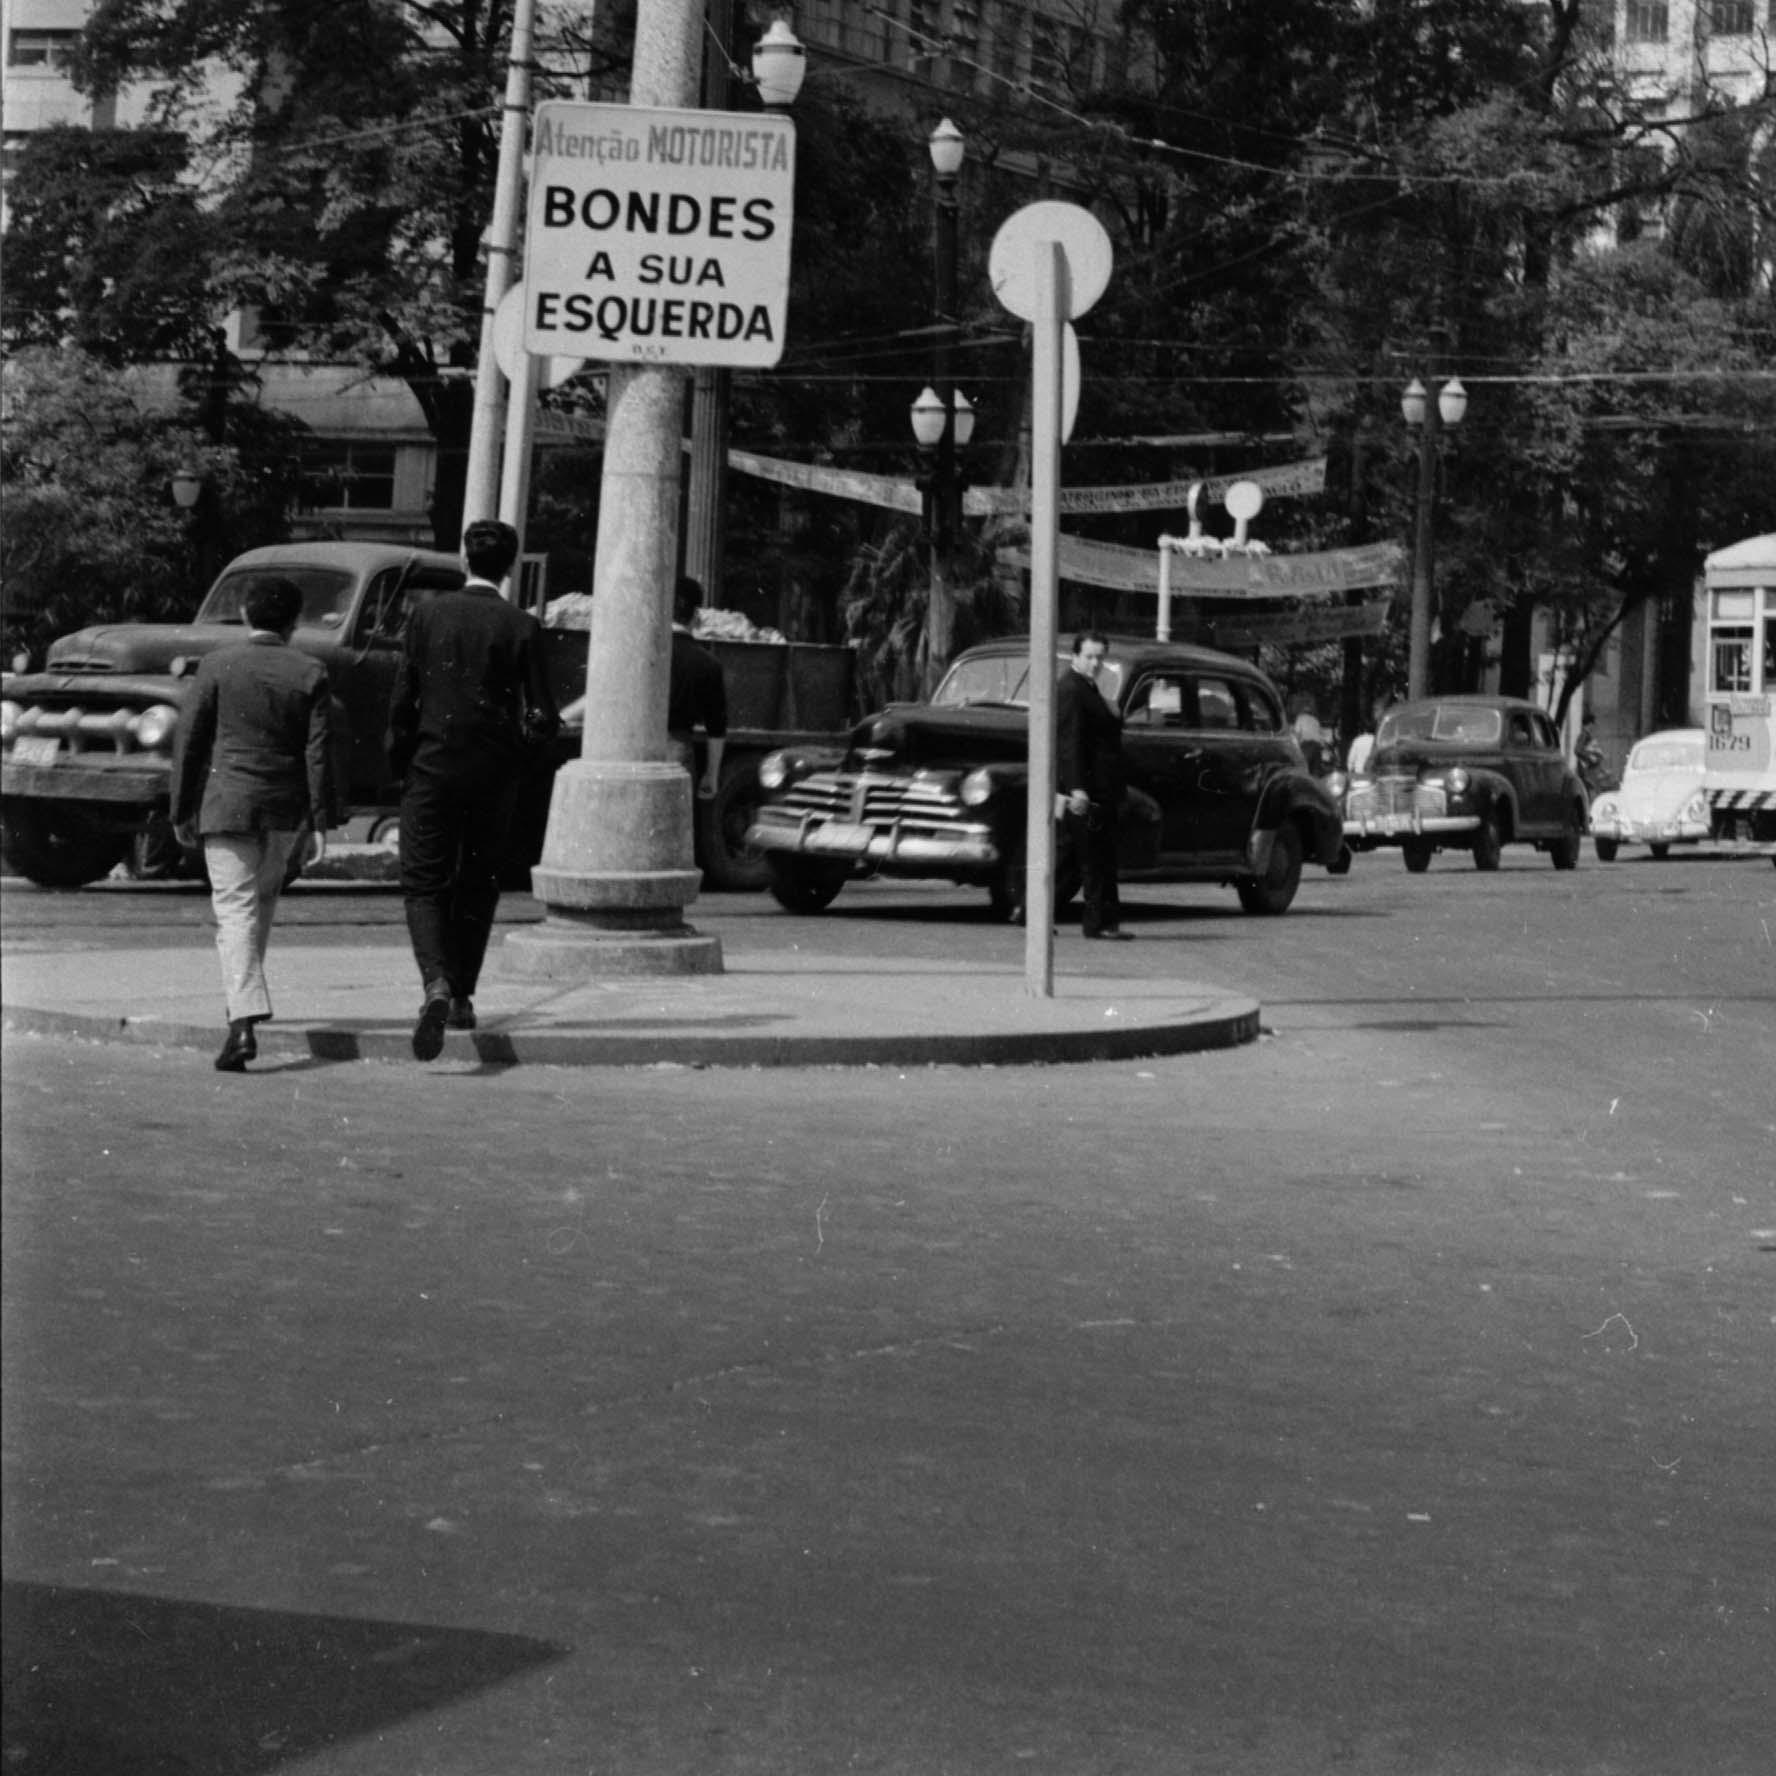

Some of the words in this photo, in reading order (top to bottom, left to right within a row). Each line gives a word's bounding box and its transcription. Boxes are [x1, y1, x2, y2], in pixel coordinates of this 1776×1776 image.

[535, 121, 641, 166] Atenção
[647, 125, 789, 172] MOTORISTA
[543, 184, 776, 242] BONDES
[584, 250, 616, 282] A
[637, 253, 726, 289] SUA
[534, 291, 775, 342] ESQUERDA
[1709, 735, 1751, 751] 1679
